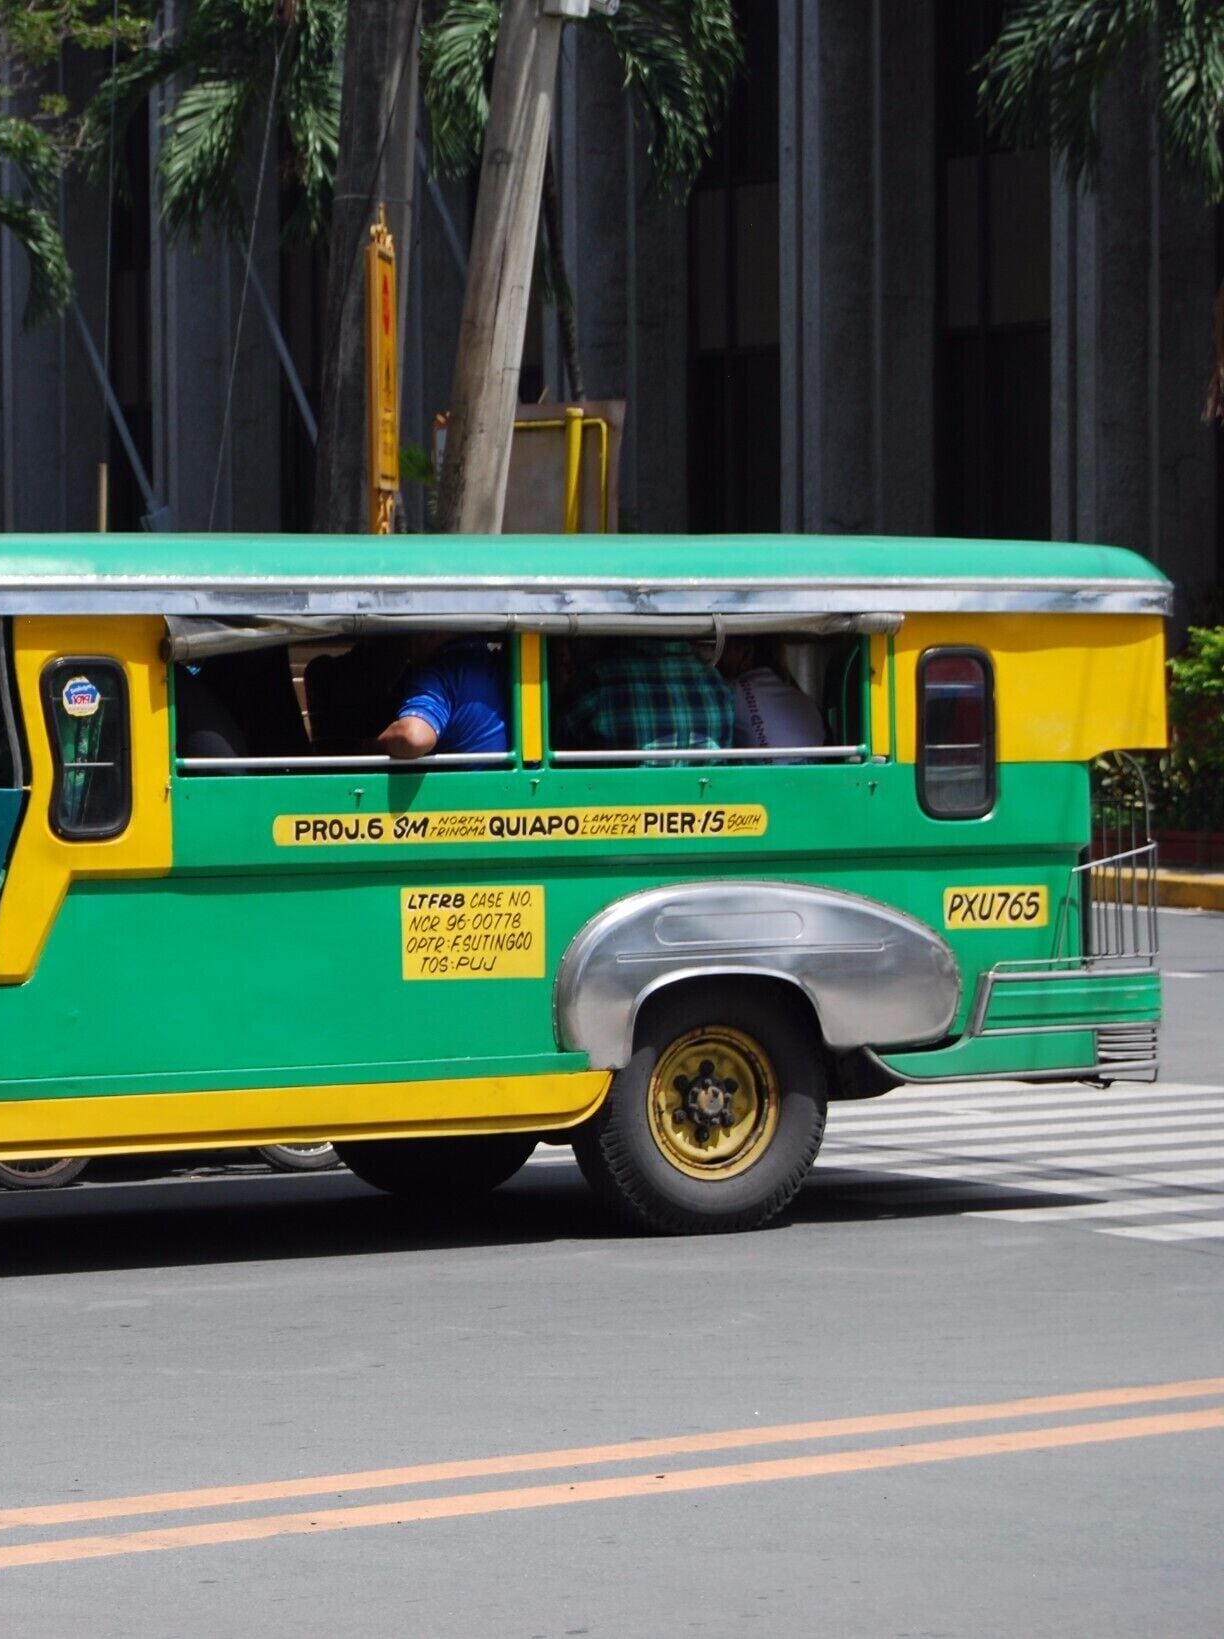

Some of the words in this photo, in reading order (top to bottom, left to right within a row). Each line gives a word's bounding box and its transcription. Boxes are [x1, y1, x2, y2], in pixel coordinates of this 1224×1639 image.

[438, 816, 485, 826] NORTH
[583, 812, 641, 823] LAWTON
[295, 818, 384, 841] PROJ.6
[392, 816, 430, 839] SM
[488, 815, 580, 838] QUIAPO
[727, 813, 761, 831] SOUTH
[429, 826, 487, 838] TRINOMA
[580, 823, 636, 835] LUNETA
[407, 893, 466, 910] LTFRB
[470, 892, 504, 908] CASE
[508, 891, 533, 907] NO.
[947, 891, 1040, 922] PXU765
[408, 915, 441, 932] NCR
